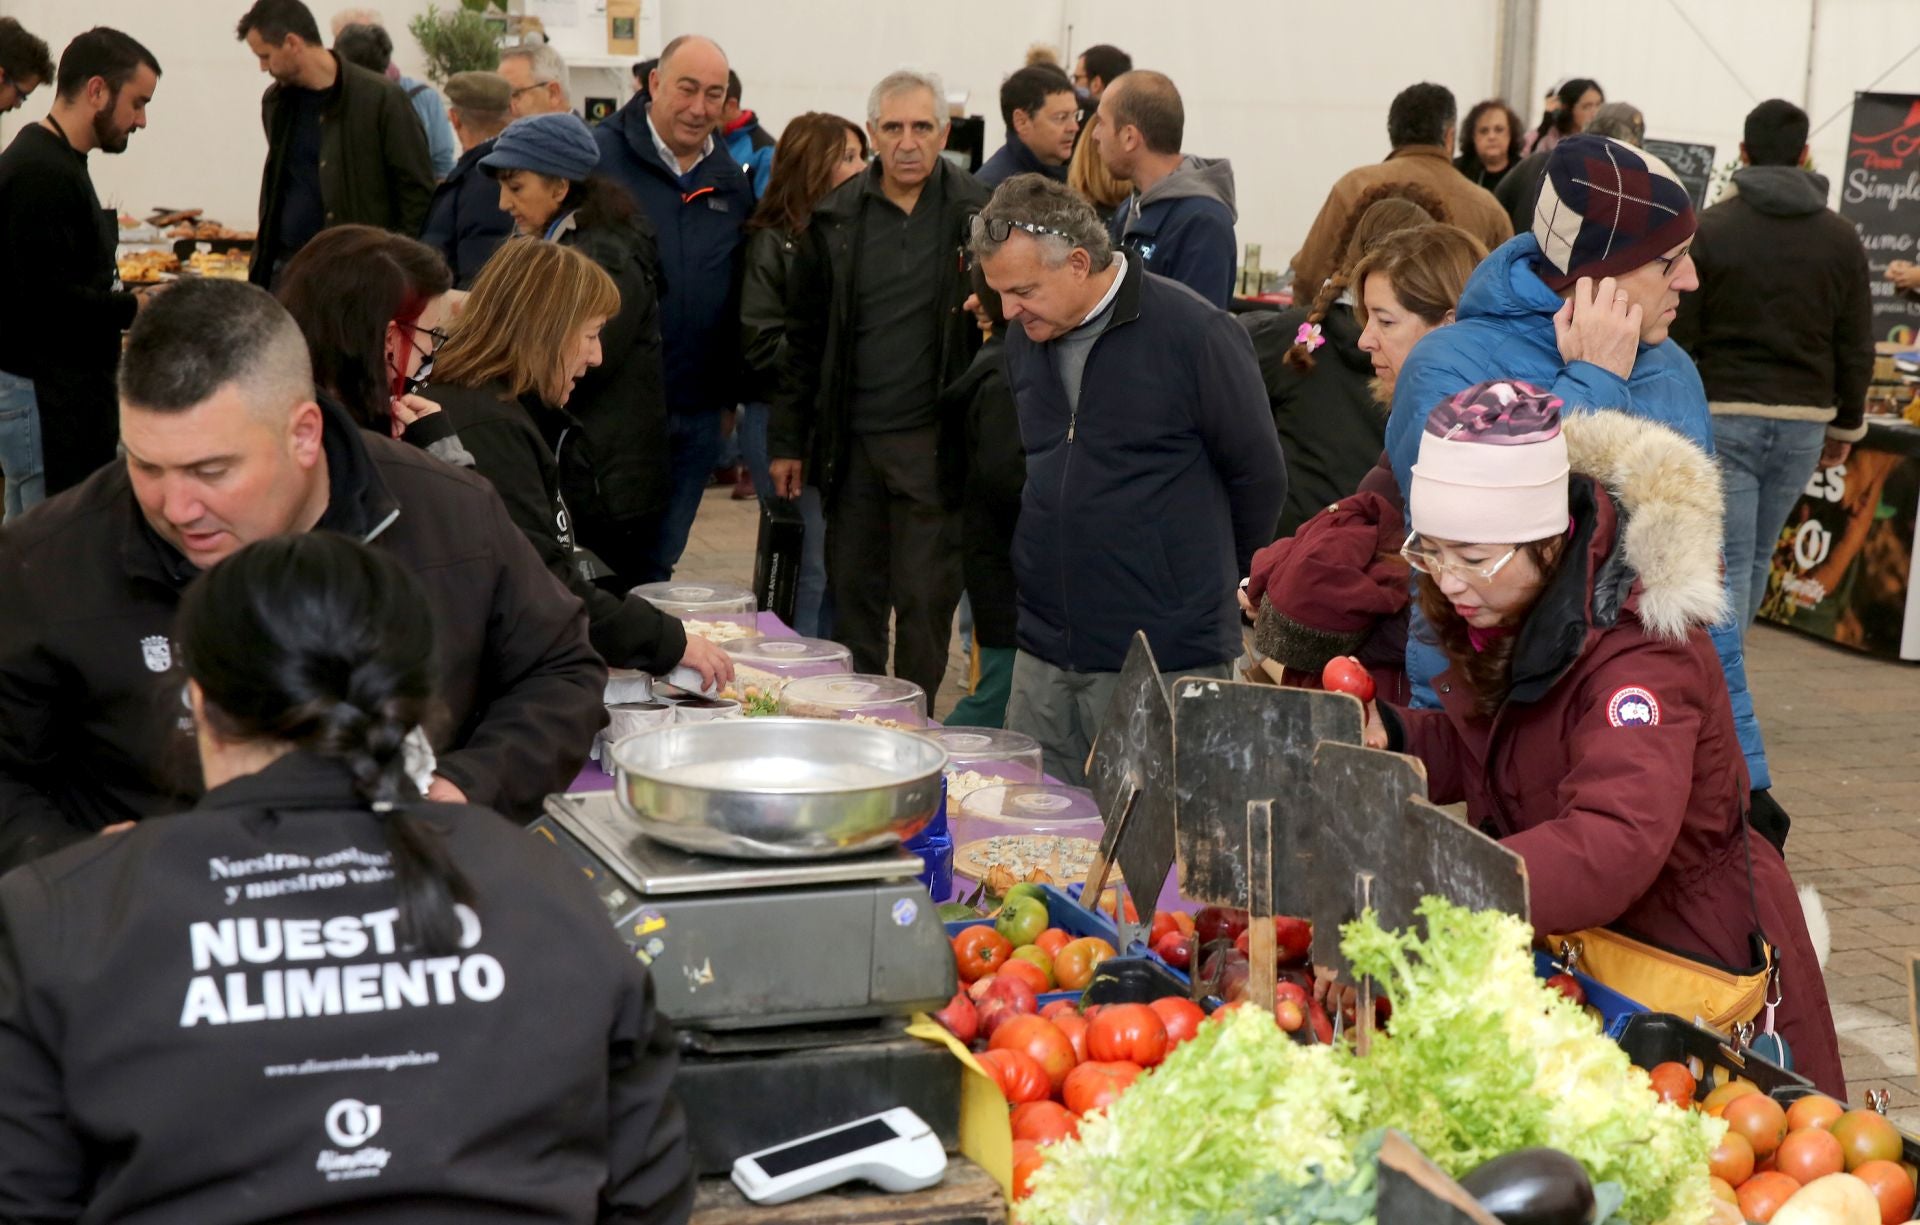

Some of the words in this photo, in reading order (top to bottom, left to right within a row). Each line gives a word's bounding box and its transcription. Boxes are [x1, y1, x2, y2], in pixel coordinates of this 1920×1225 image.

[1806, 464, 1847, 503] ES
[208, 851, 311, 881] Nuestras
[224, 884, 241, 905] y
[245, 868, 348, 901] nuestros
[189, 902, 483, 972] NUESTO
[178, 952, 506, 1028] ALIMENTO
